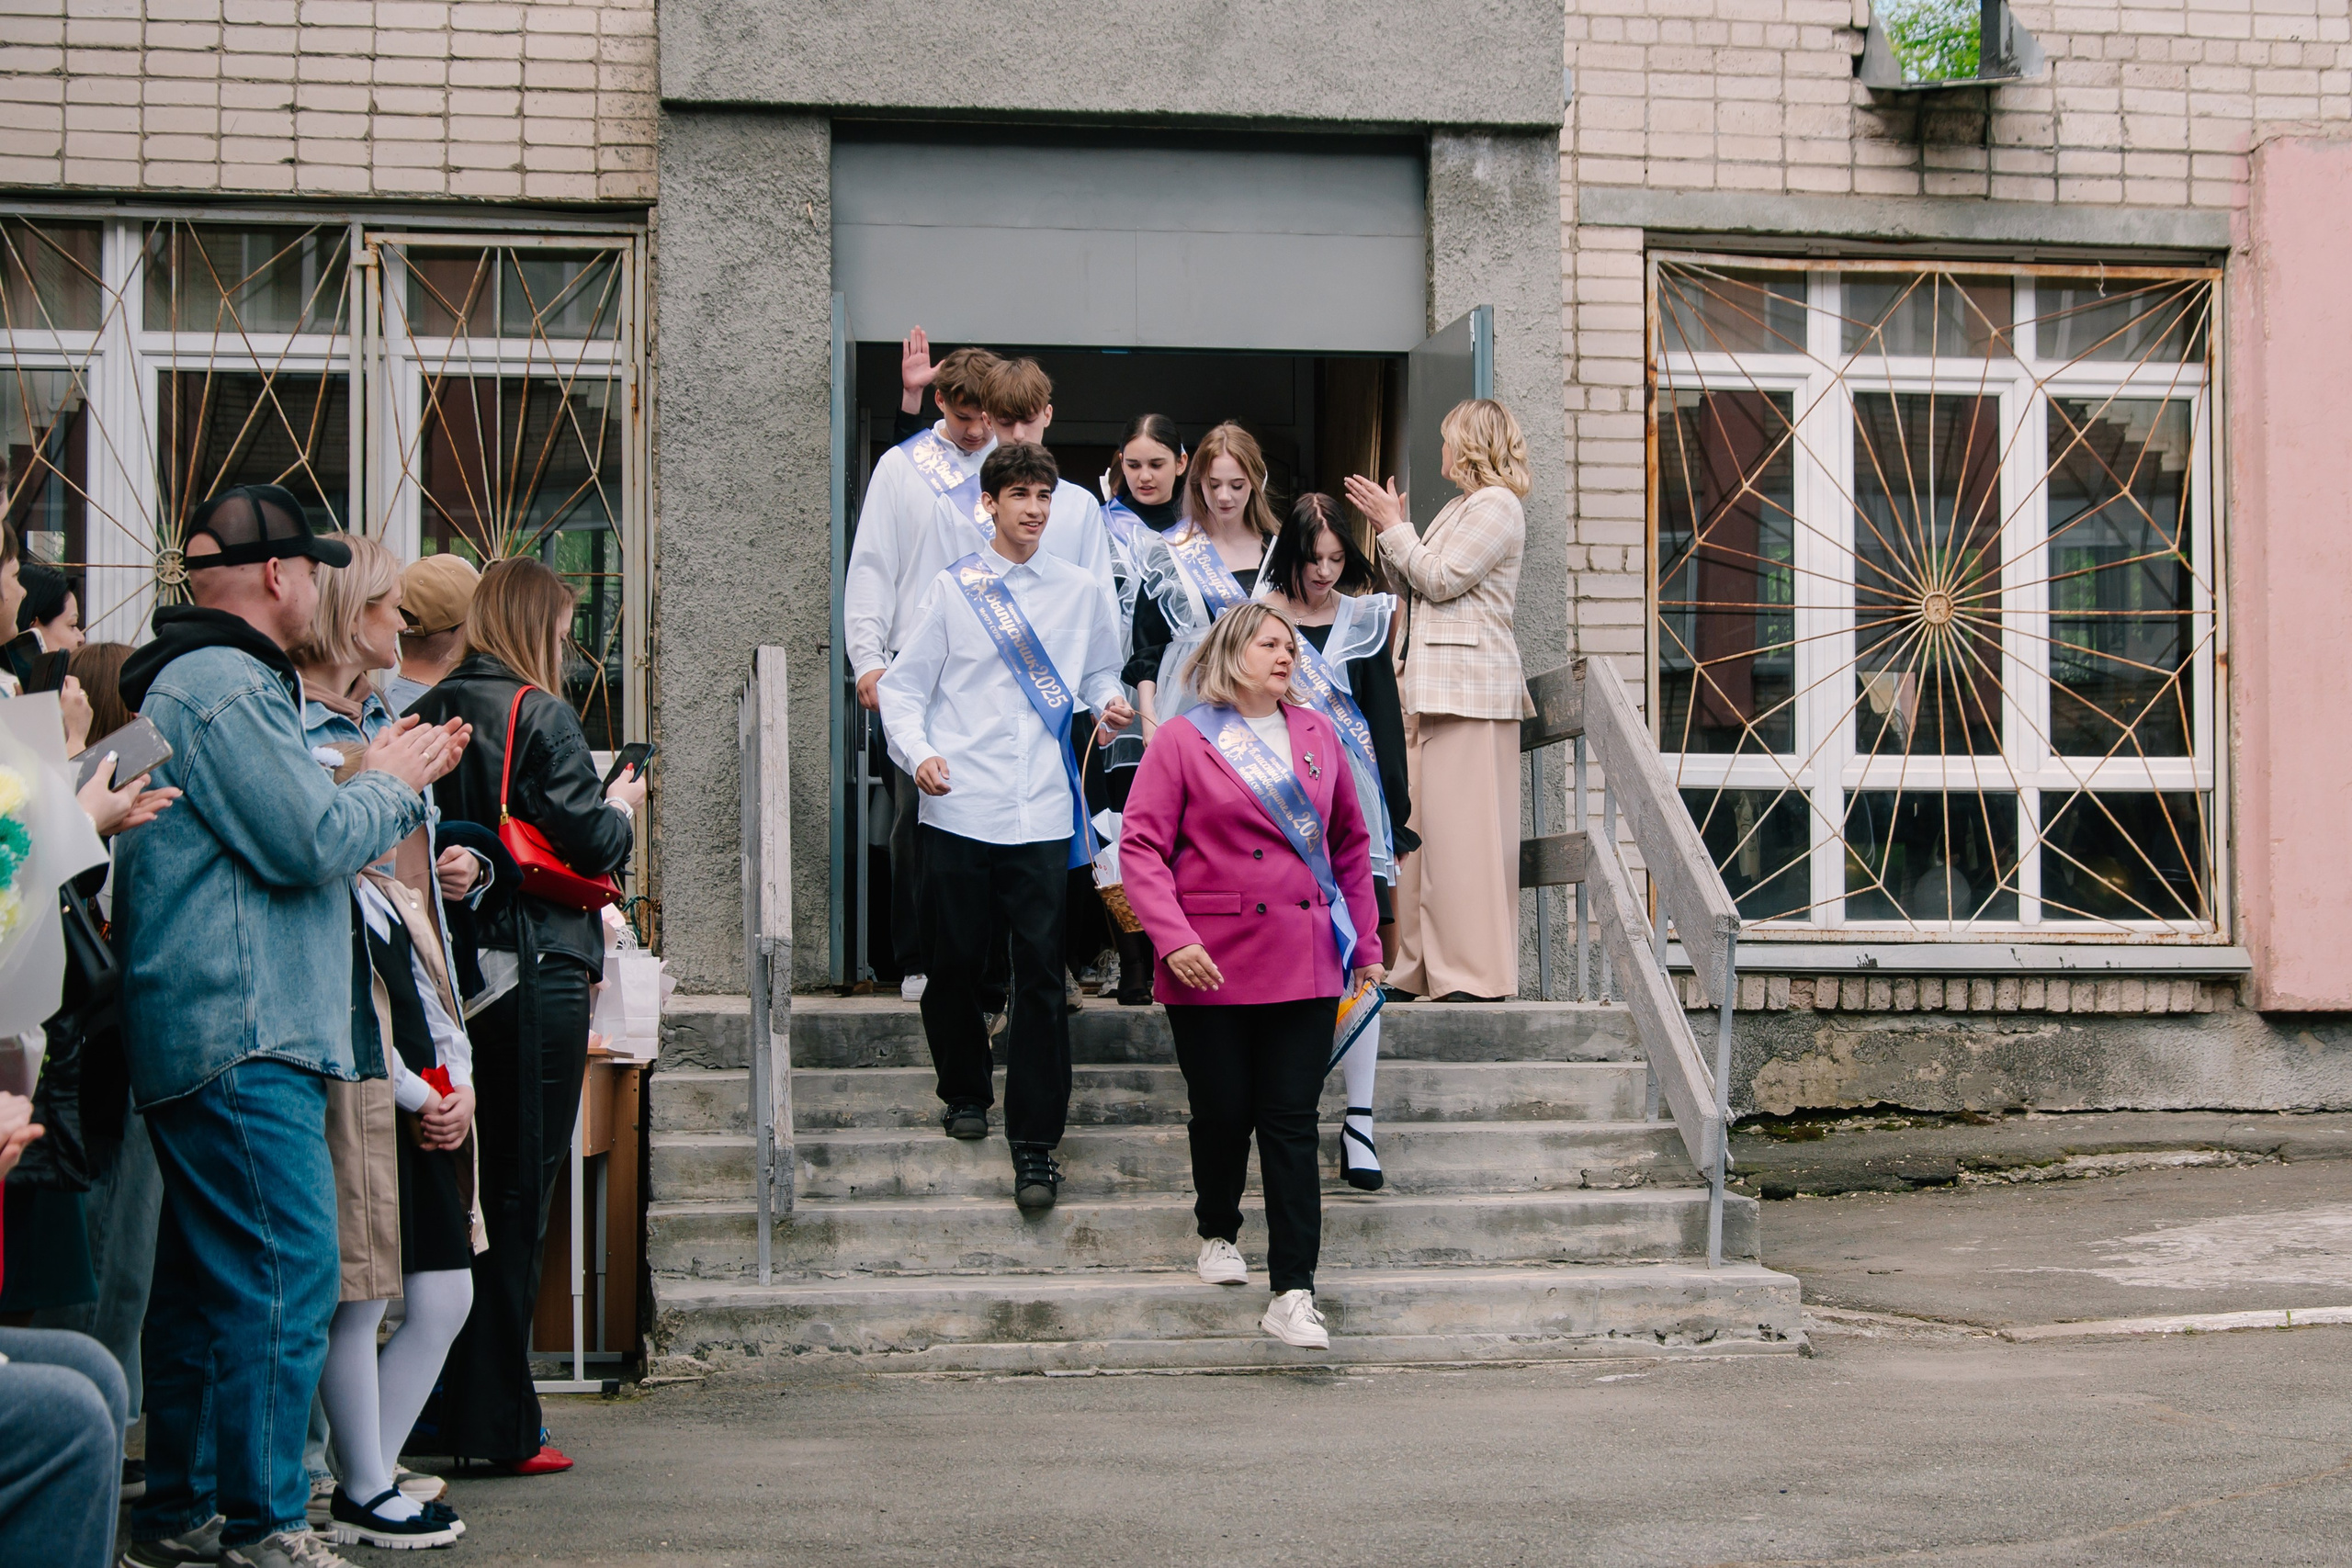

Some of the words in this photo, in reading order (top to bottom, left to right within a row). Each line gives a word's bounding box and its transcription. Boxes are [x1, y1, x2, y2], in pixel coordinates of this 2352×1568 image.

[985, 589, 1038, 670] Выпускник
[1029, 665, 1069, 707] 2025
[1300, 655, 1352, 726] Выпускница
[1246, 762, 1294, 821] руководитель
[1249, 747, 1283, 784] Классный
